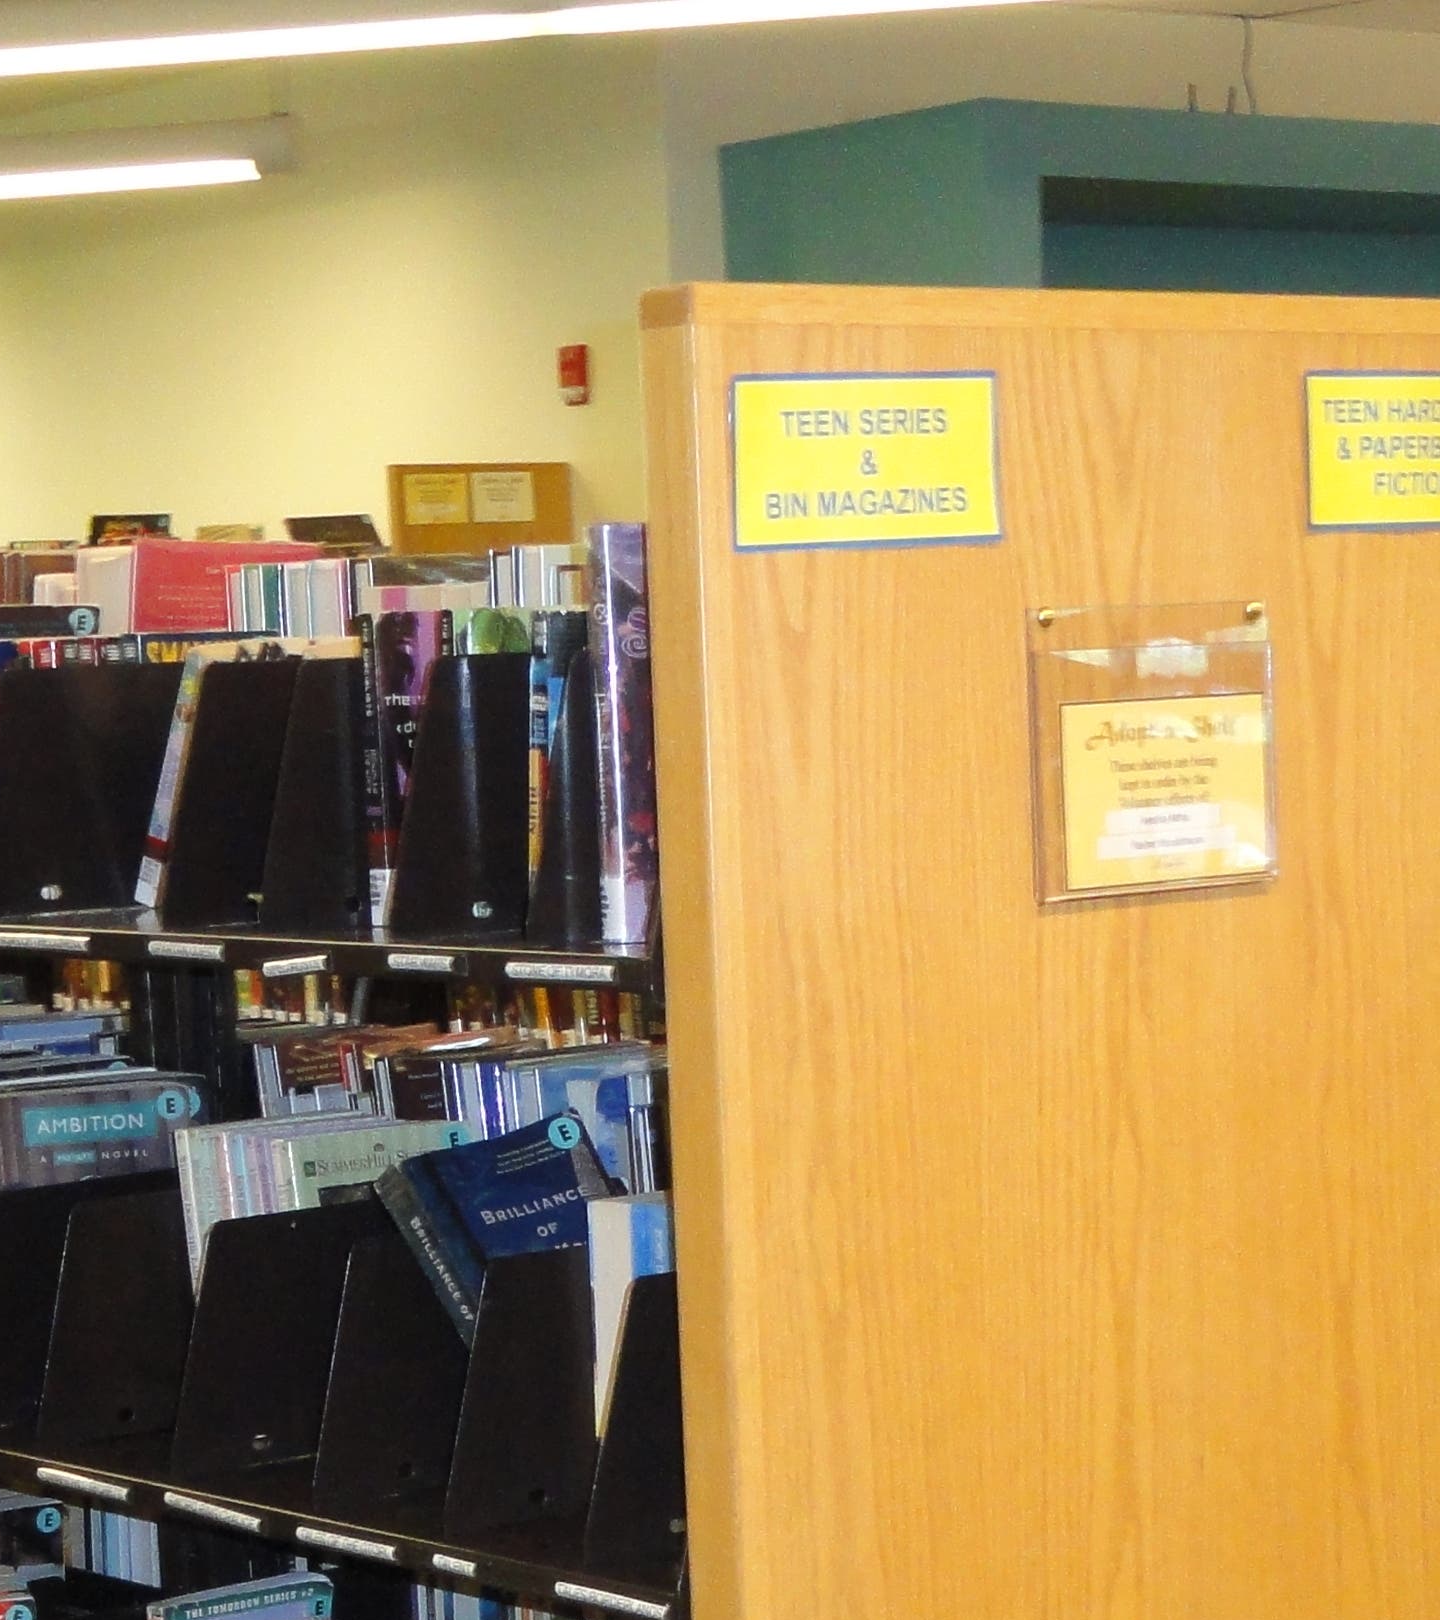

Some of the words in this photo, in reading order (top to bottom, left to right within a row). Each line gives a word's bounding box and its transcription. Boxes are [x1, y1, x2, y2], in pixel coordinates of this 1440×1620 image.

[780, 409, 849, 437] TEEN
[859, 407, 948, 436] SERIES
[1322, 399, 1380, 424] TEEN
[1337, 436, 1352, 460] &
[860, 449, 878, 475] &
[765, 492, 809, 520] BIN
[817, 486, 968, 517] MAGAZINES
[166, 1098, 176, 1114] E
[37, 1113, 144, 1135] AMBITION
[557, 1123, 573, 1143] E
[101, 1149, 149, 1160] NOVEL
[480, 1184, 589, 1226] BRILLIANCE
[536, 1222, 559, 1239] OF
[44, 1512, 54, 1528] E
